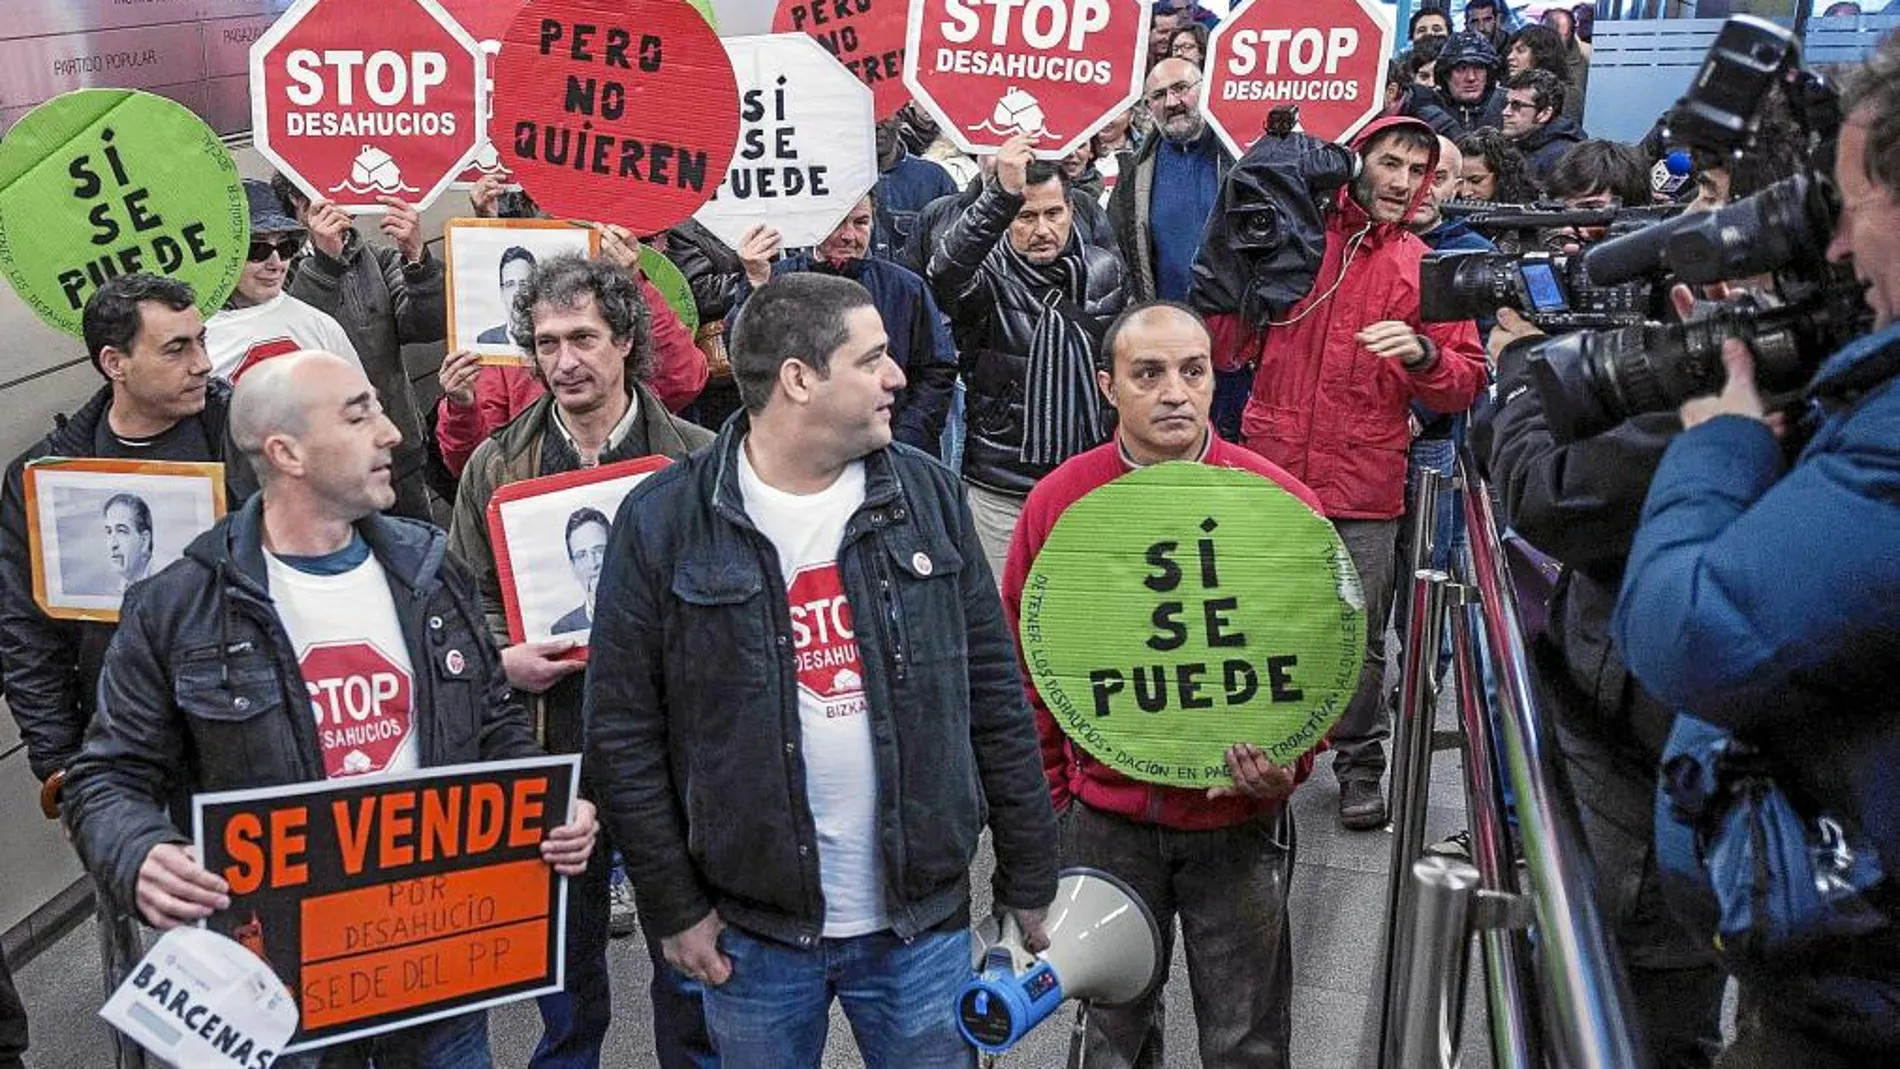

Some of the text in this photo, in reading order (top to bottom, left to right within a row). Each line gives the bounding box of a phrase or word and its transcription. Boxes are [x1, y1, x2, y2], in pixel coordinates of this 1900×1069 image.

[540, 18, 662, 72] PERO
[941, 0, 1110, 51] STOP
[54, 50, 157, 76] PARTIDO POPULAR
[936, 48, 1112, 84] DESAHUCIOS
[1228, 27, 1359, 75] STOP
[285, 49, 447, 106] STOP
[565, 75, 625, 120] NO
[1222, 80, 1358, 101] DESAHUCIOS
[287, 112, 456, 136] DESAHUCIOS
[741, 127, 797, 160] SE
[711, 166, 829, 200] UEDE
[88, 187, 163, 246] SE
[790, 594, 854, 648] STO
[1146, 597, 1246, 651] SE
[793, 643, 860, 673] DESAHU
[826, 700, 870, 719] BIZKA
[1089, 655, 1304, 718] PUEDE
[321, 718, 402, 750] SAHUCIOS
[1031, 649, 1053, 677] LOS
[1178, 766, 1196, 779] EN
[1205, 766, 1231, 778] PAG
[1271, 694, 1339, 759] TROACTIVA
[224, 777, 548, 895] SE VENDE
[388, 876, 447, 907] POR
[304, 966, 388, 1014] SEDE
[403, 953, 448, 992] DEL
[132, 962, 273, 1069] BARCENAS
